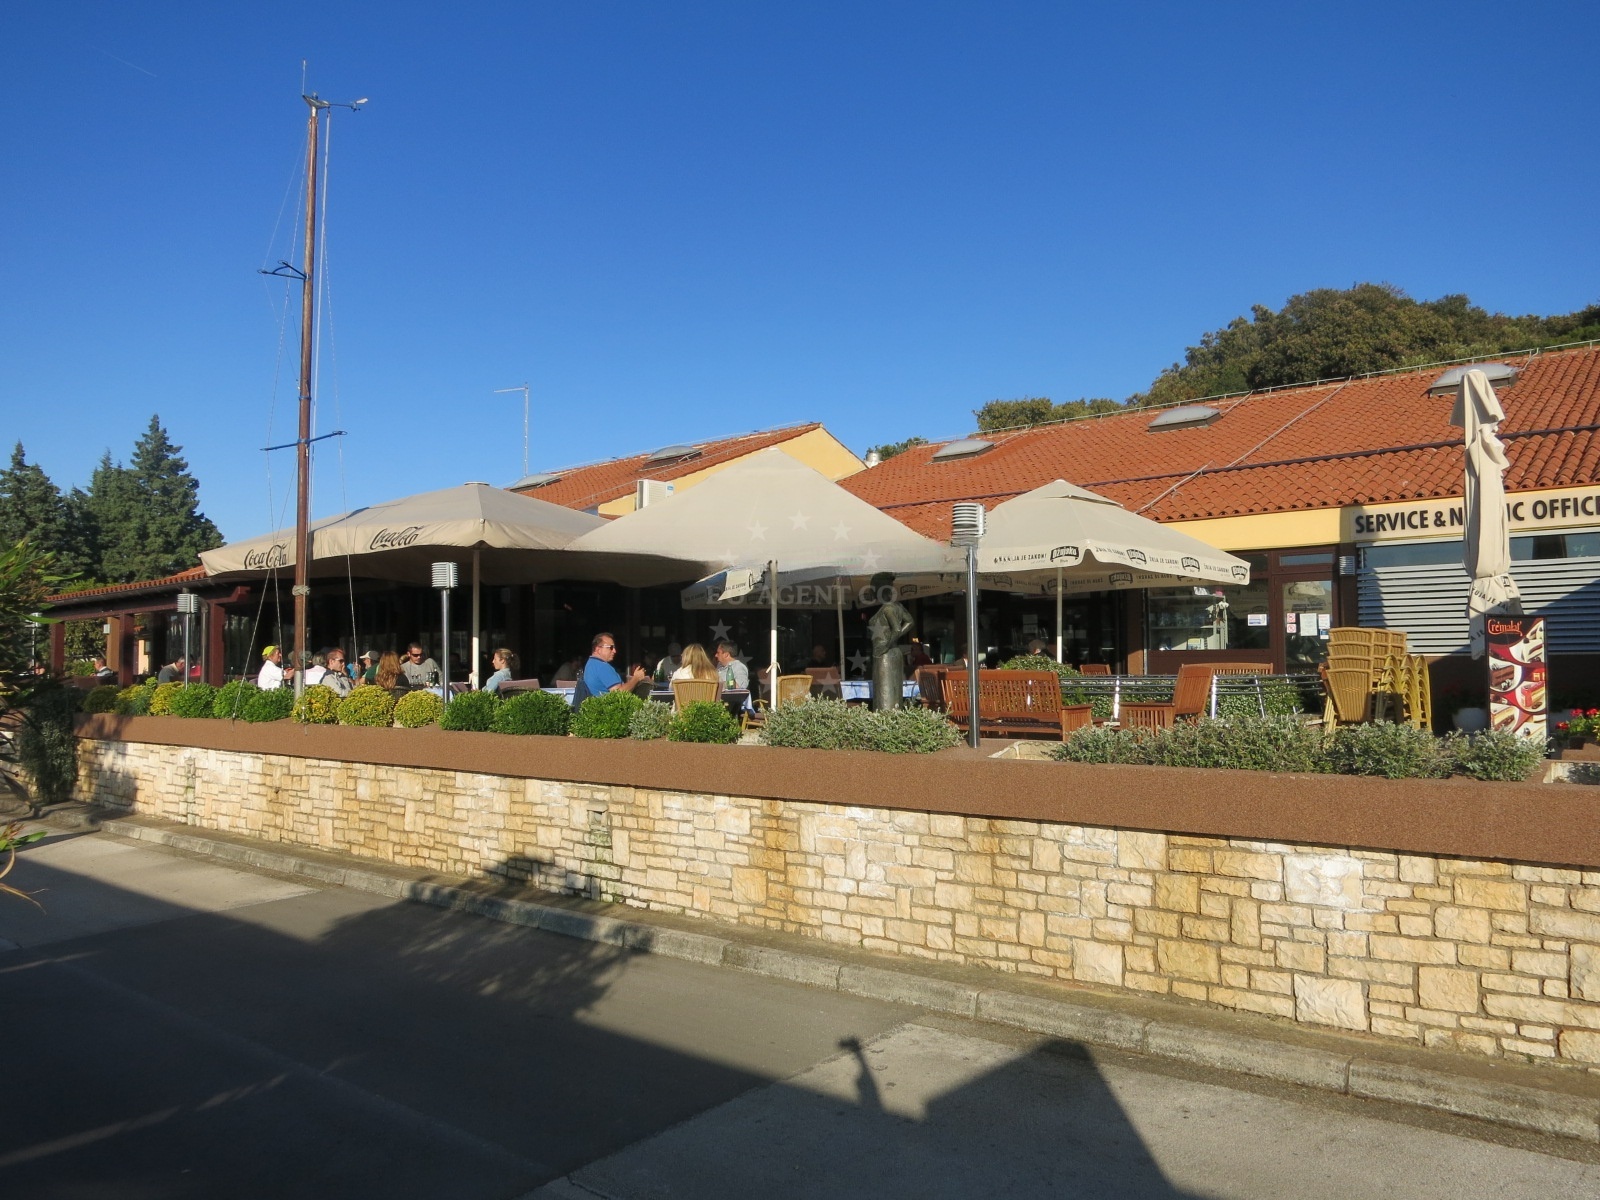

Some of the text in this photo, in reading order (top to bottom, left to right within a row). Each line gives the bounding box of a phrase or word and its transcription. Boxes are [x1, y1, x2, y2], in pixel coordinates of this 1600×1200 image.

[1355, 510, 1429, 534] SERVICE
[1434, 510, 1446, 528] &
[369, 525, 425, 550] Coca-Cola
[243, 543, 288, 569] Coca-Cola
